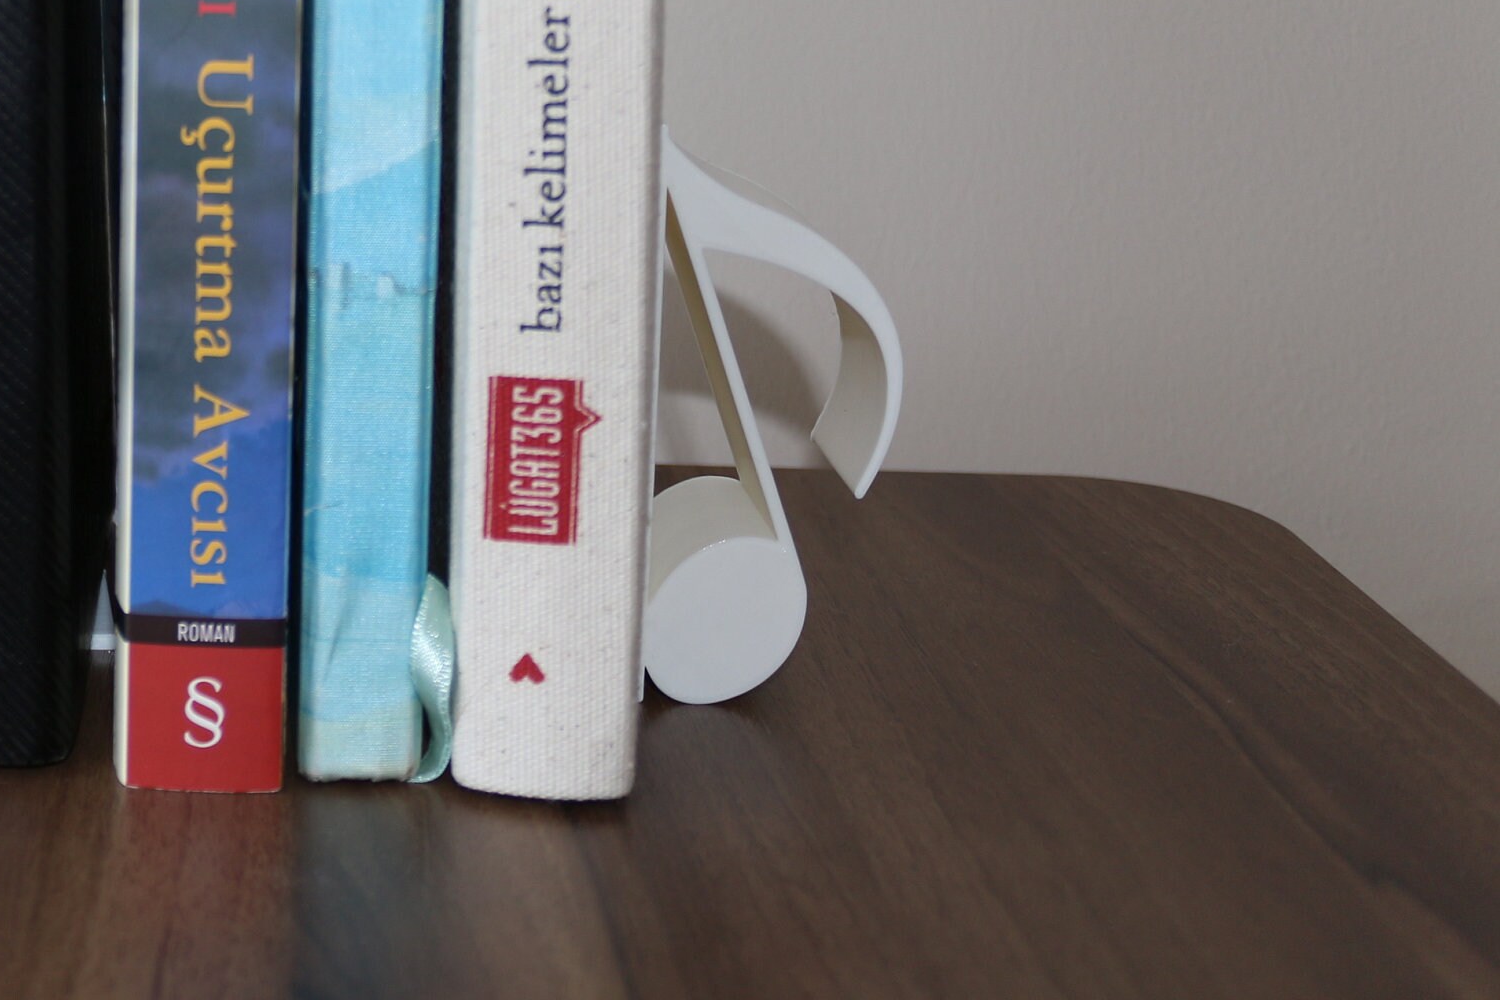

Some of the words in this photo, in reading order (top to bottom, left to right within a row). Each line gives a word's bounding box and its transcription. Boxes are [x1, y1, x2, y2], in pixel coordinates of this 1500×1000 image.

[522, 7, 572, 230] kelimeler
[180, 55, 254, 363] Uçurtma
[519, 244, 564, 333] bazı
[177, 621, 236, 644] ROMAN
